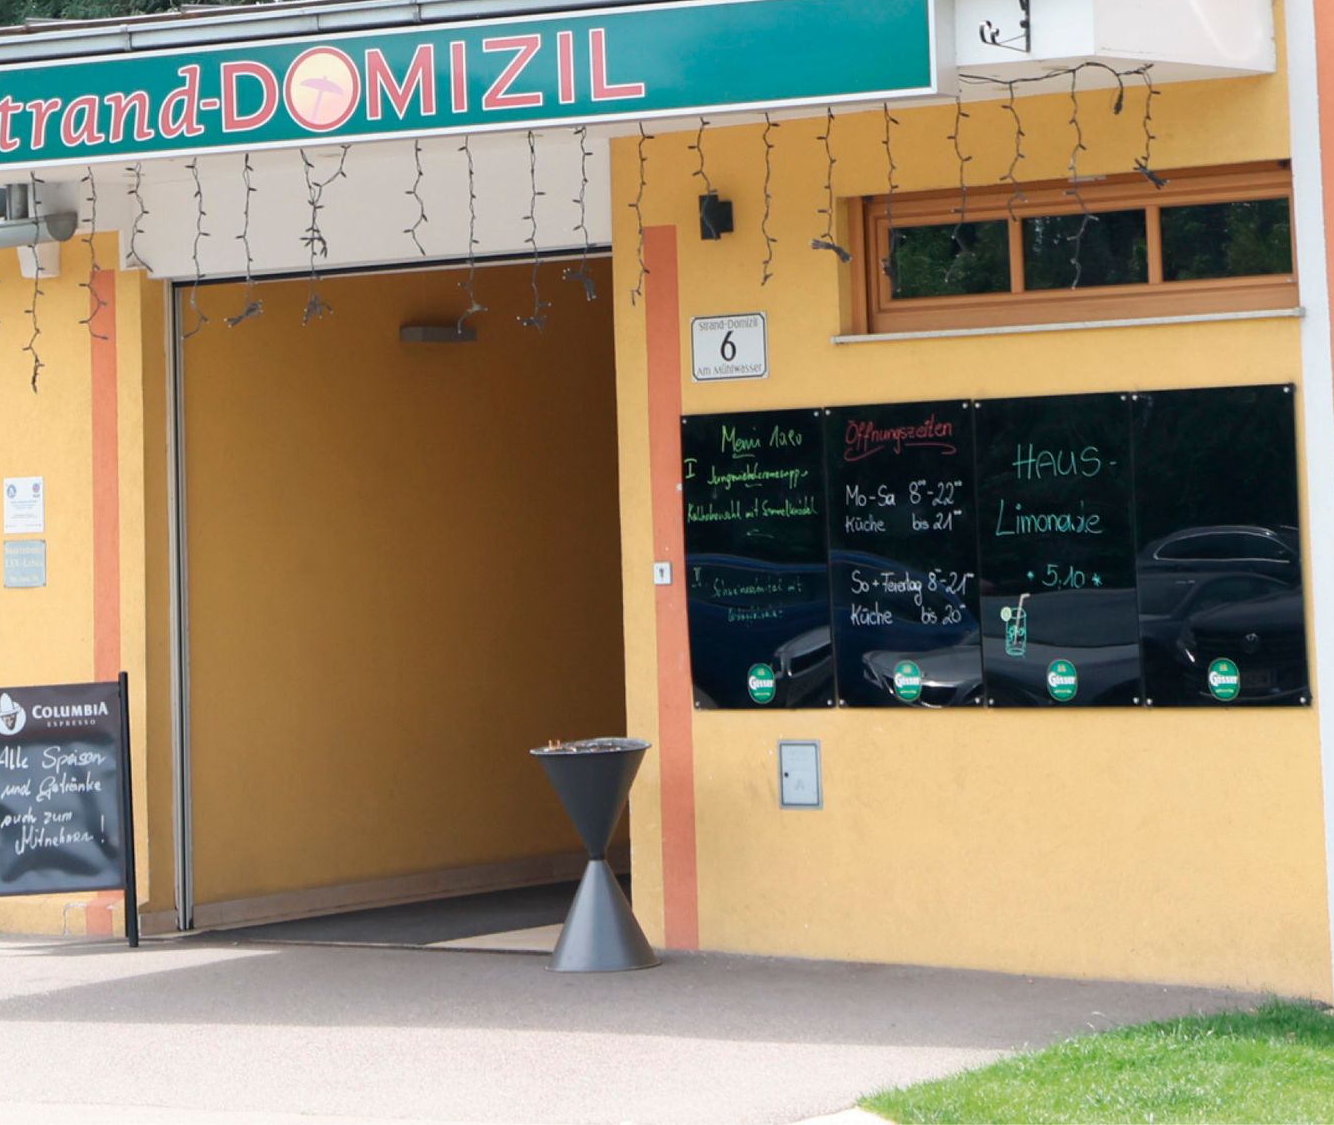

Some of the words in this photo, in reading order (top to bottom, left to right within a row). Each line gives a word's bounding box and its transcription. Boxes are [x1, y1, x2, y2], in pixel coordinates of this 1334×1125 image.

[720, 330, 737, 362] 6
[844, 413, 953, 455] Öffnungszeiten
[845, 513, 887, 534] Küche
[911, 512, 930, 531] bis
[995, 498, 1104, 537] Limonade
[850, 569, 870, 594] So
[850, 600, 894, 627] Küche
[920, 604, 938, 625] bis
[31, 700, 109, 720] COLUMBIA
[46, 718, 97, 728] ESPRESSO
[41, 746, 107, 774] Speisen
[0, 777, 32, 800] und
[35, 772, 102, 802] Getränke
[0, 806, 38, 829] auch
[43, 810, 73, 825] zum
